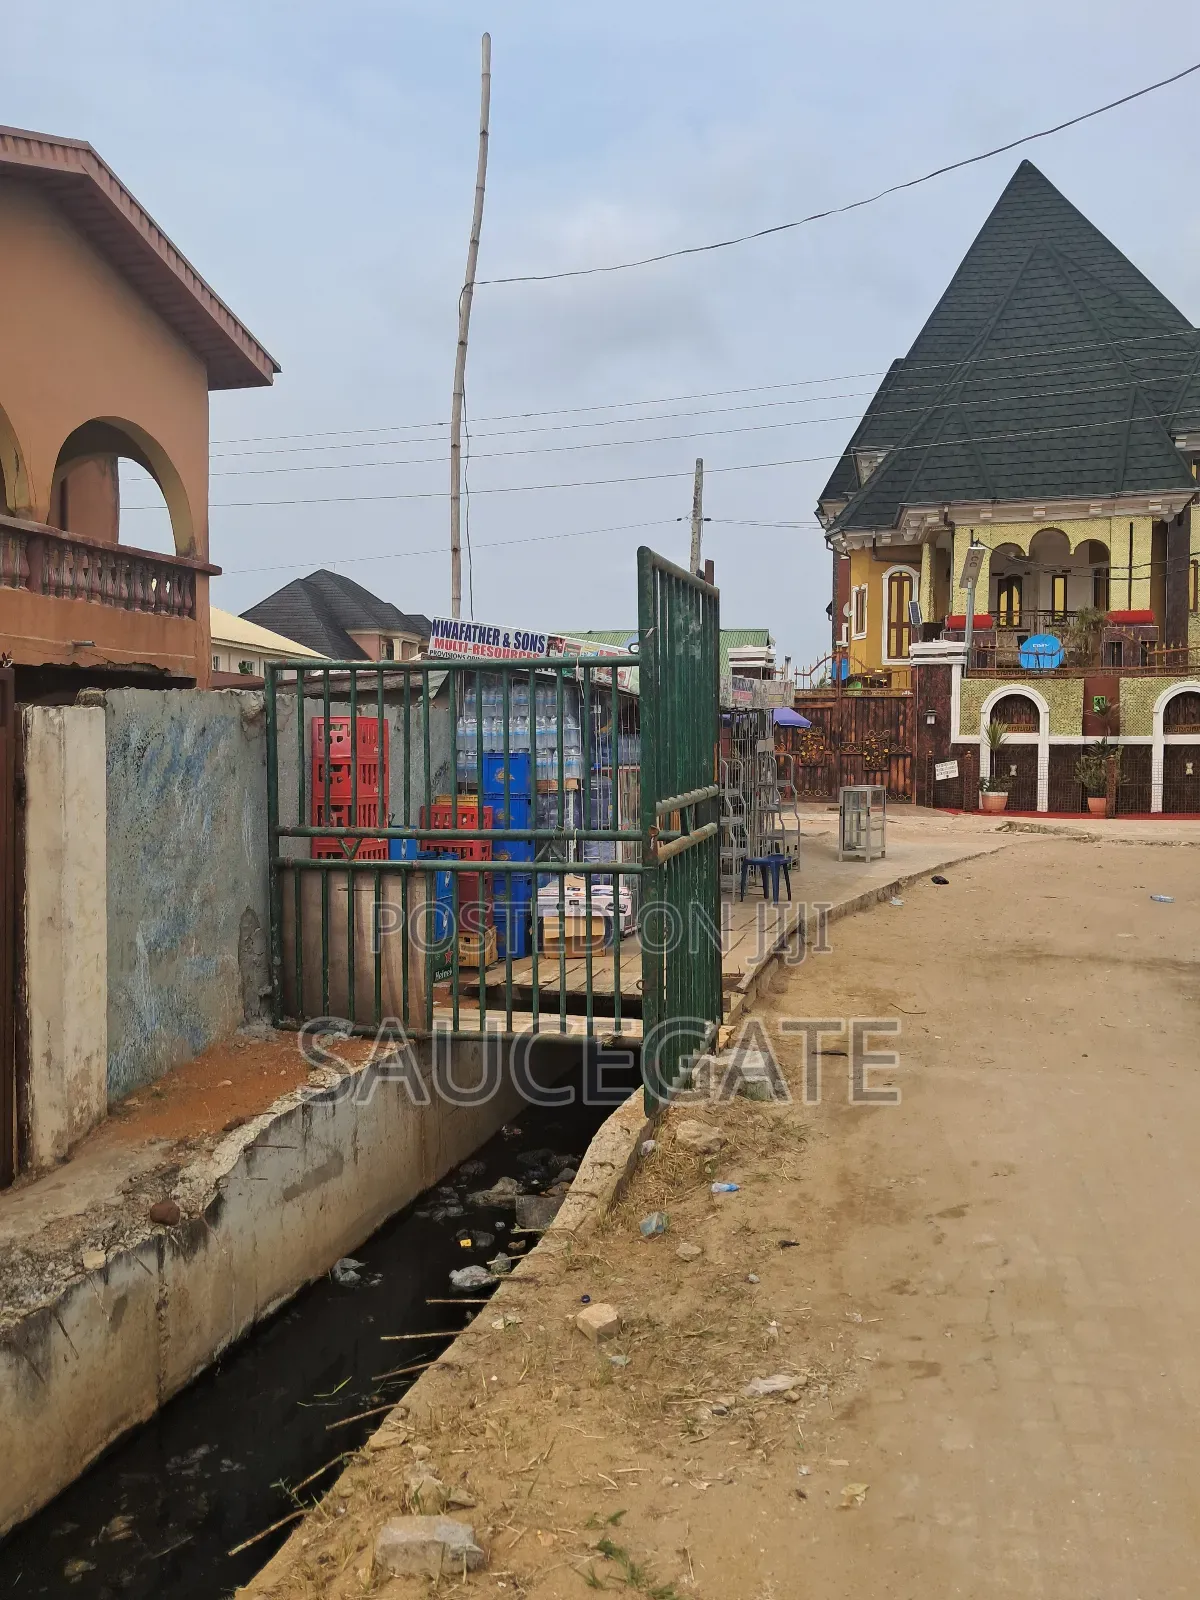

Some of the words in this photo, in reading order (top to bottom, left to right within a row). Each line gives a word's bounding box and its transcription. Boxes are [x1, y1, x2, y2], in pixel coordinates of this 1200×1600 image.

[432, 619, 501, 646] NWAFATHER
[503, 632, 512, 648] &
[514, 632, 545, 653] SONS
